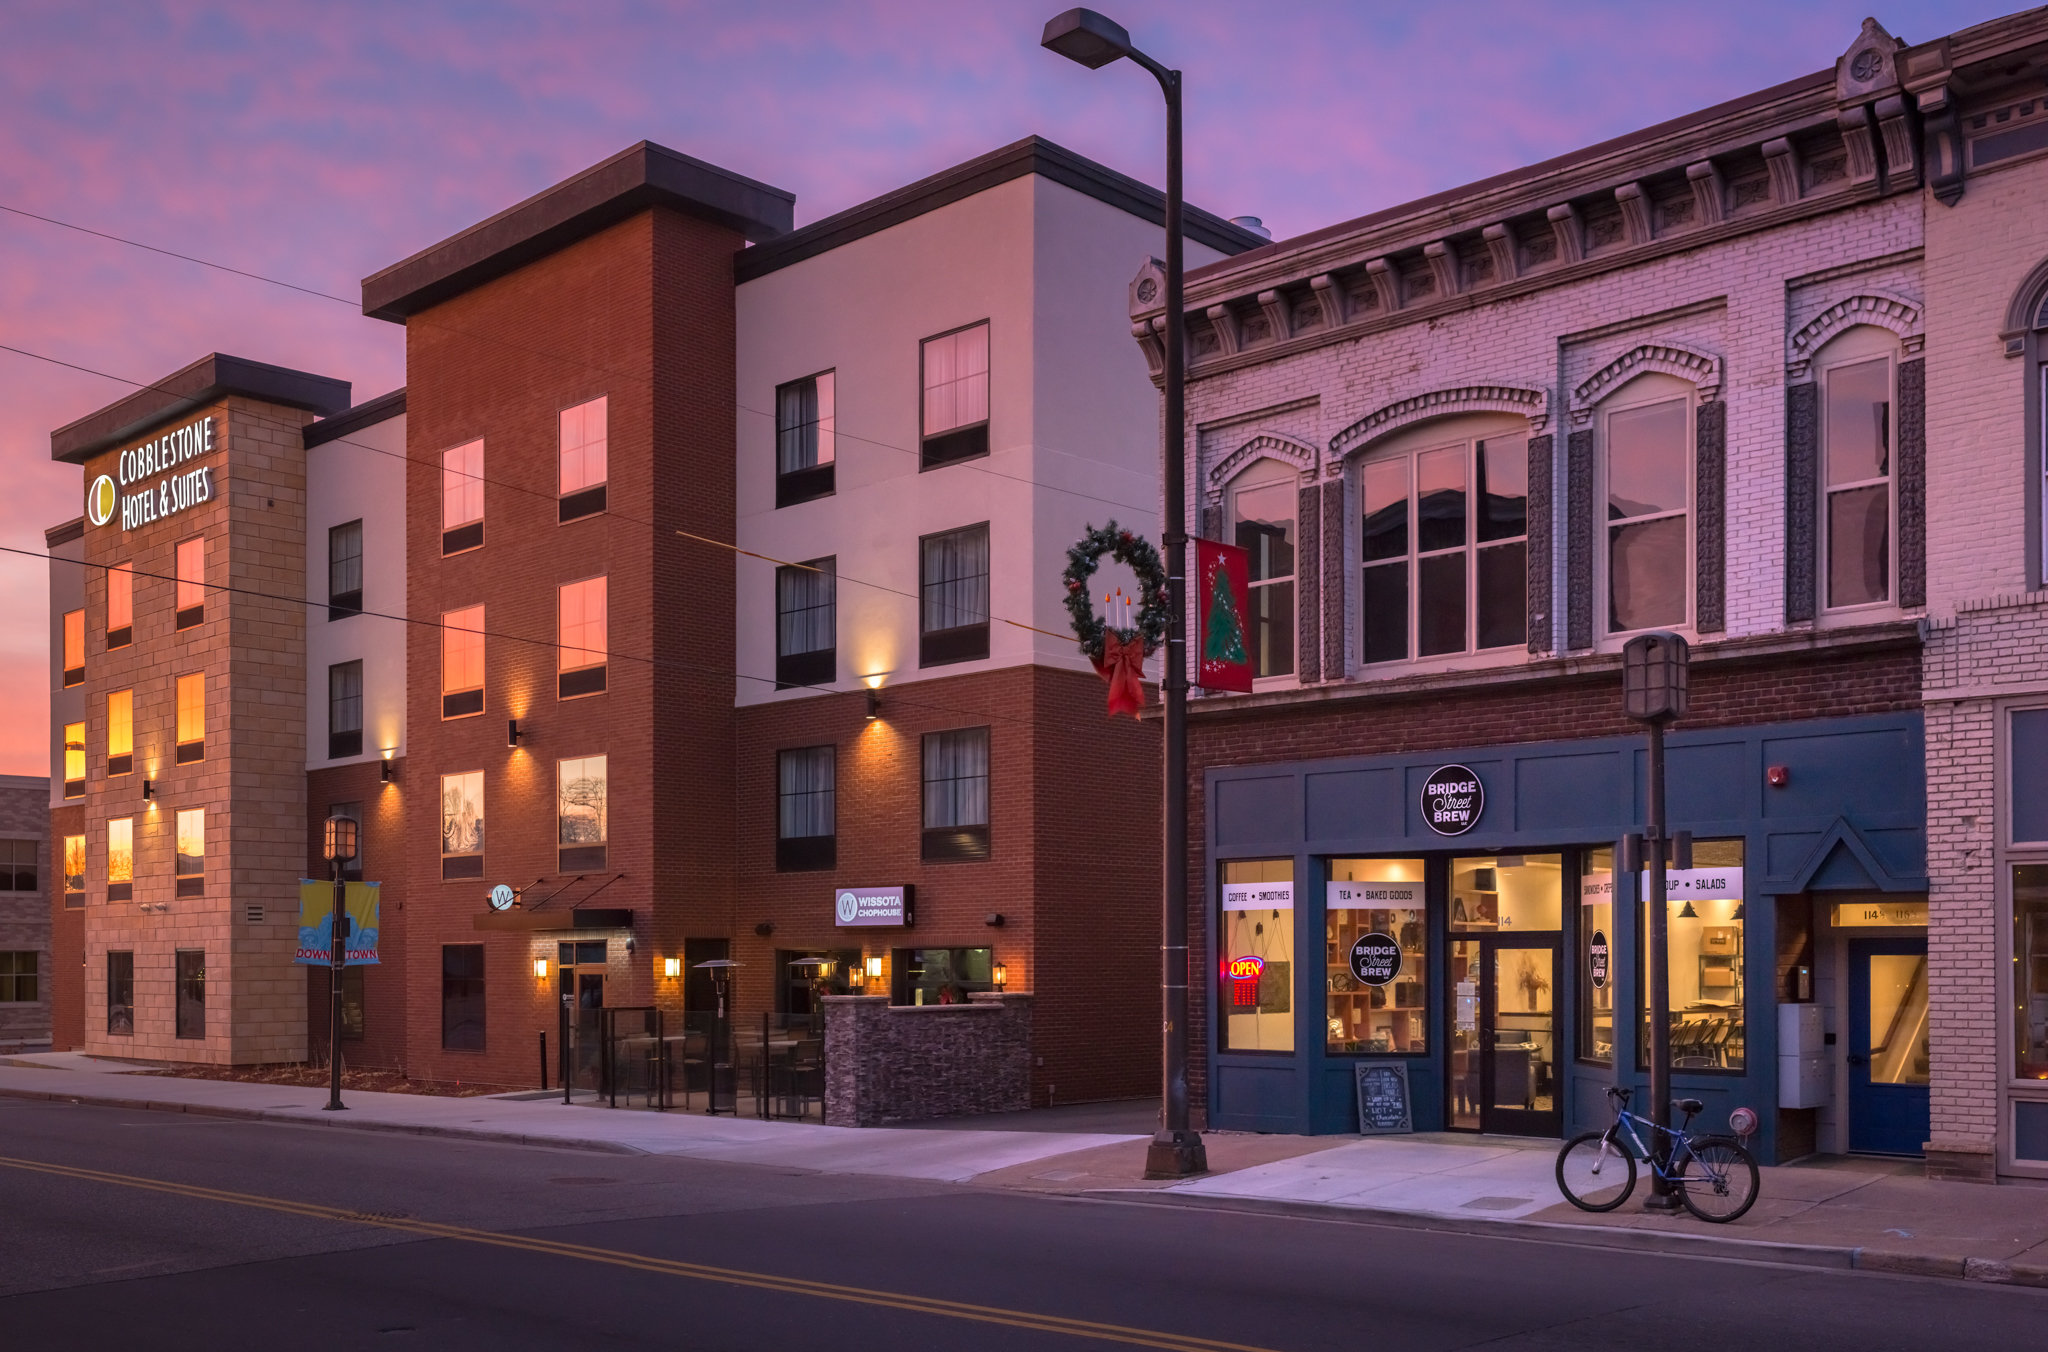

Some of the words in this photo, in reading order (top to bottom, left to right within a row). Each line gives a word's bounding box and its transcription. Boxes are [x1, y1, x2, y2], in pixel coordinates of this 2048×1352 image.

[120, 416, 211, 486] COBBLESTONE
[122, 488, 157, 531] HOTEL
[160, 480, 168, 517] &
[171, 466, 208, 513] SUITES
[1428, 781, 1476, 795] BRIDGE
[1433, 792, 1471, 812] Street
[1434, 810, 1470, 822] BREW
[1695, 879, 1725, 889] SALADS
[496, 890, 510, 905] W
[1228, 892, 1247, 902] COFFEE
[1258, 891, 1289, 900] SMOOTHIES
[1339, 890, 1351, 899] TEA
[1365, 890, 1387, 899] BAKED
[1390, 890, 1413, 899] GOODS
[842, 899, 854, 915] W
[858, 896, 901, 907] WISSOTA
[858, 908, 901, 917] CHOPHOUSE
[296, 948, 330, 960] DOWN
[346, 949, 377, 959] TOWN
[1356, 946, 1396, 955] BRIDGE
[1360, 954, 1392, 968] Street
[1231, 962, 1259, 975] OPEN
[1361, 968, 1391, 976] BREW
